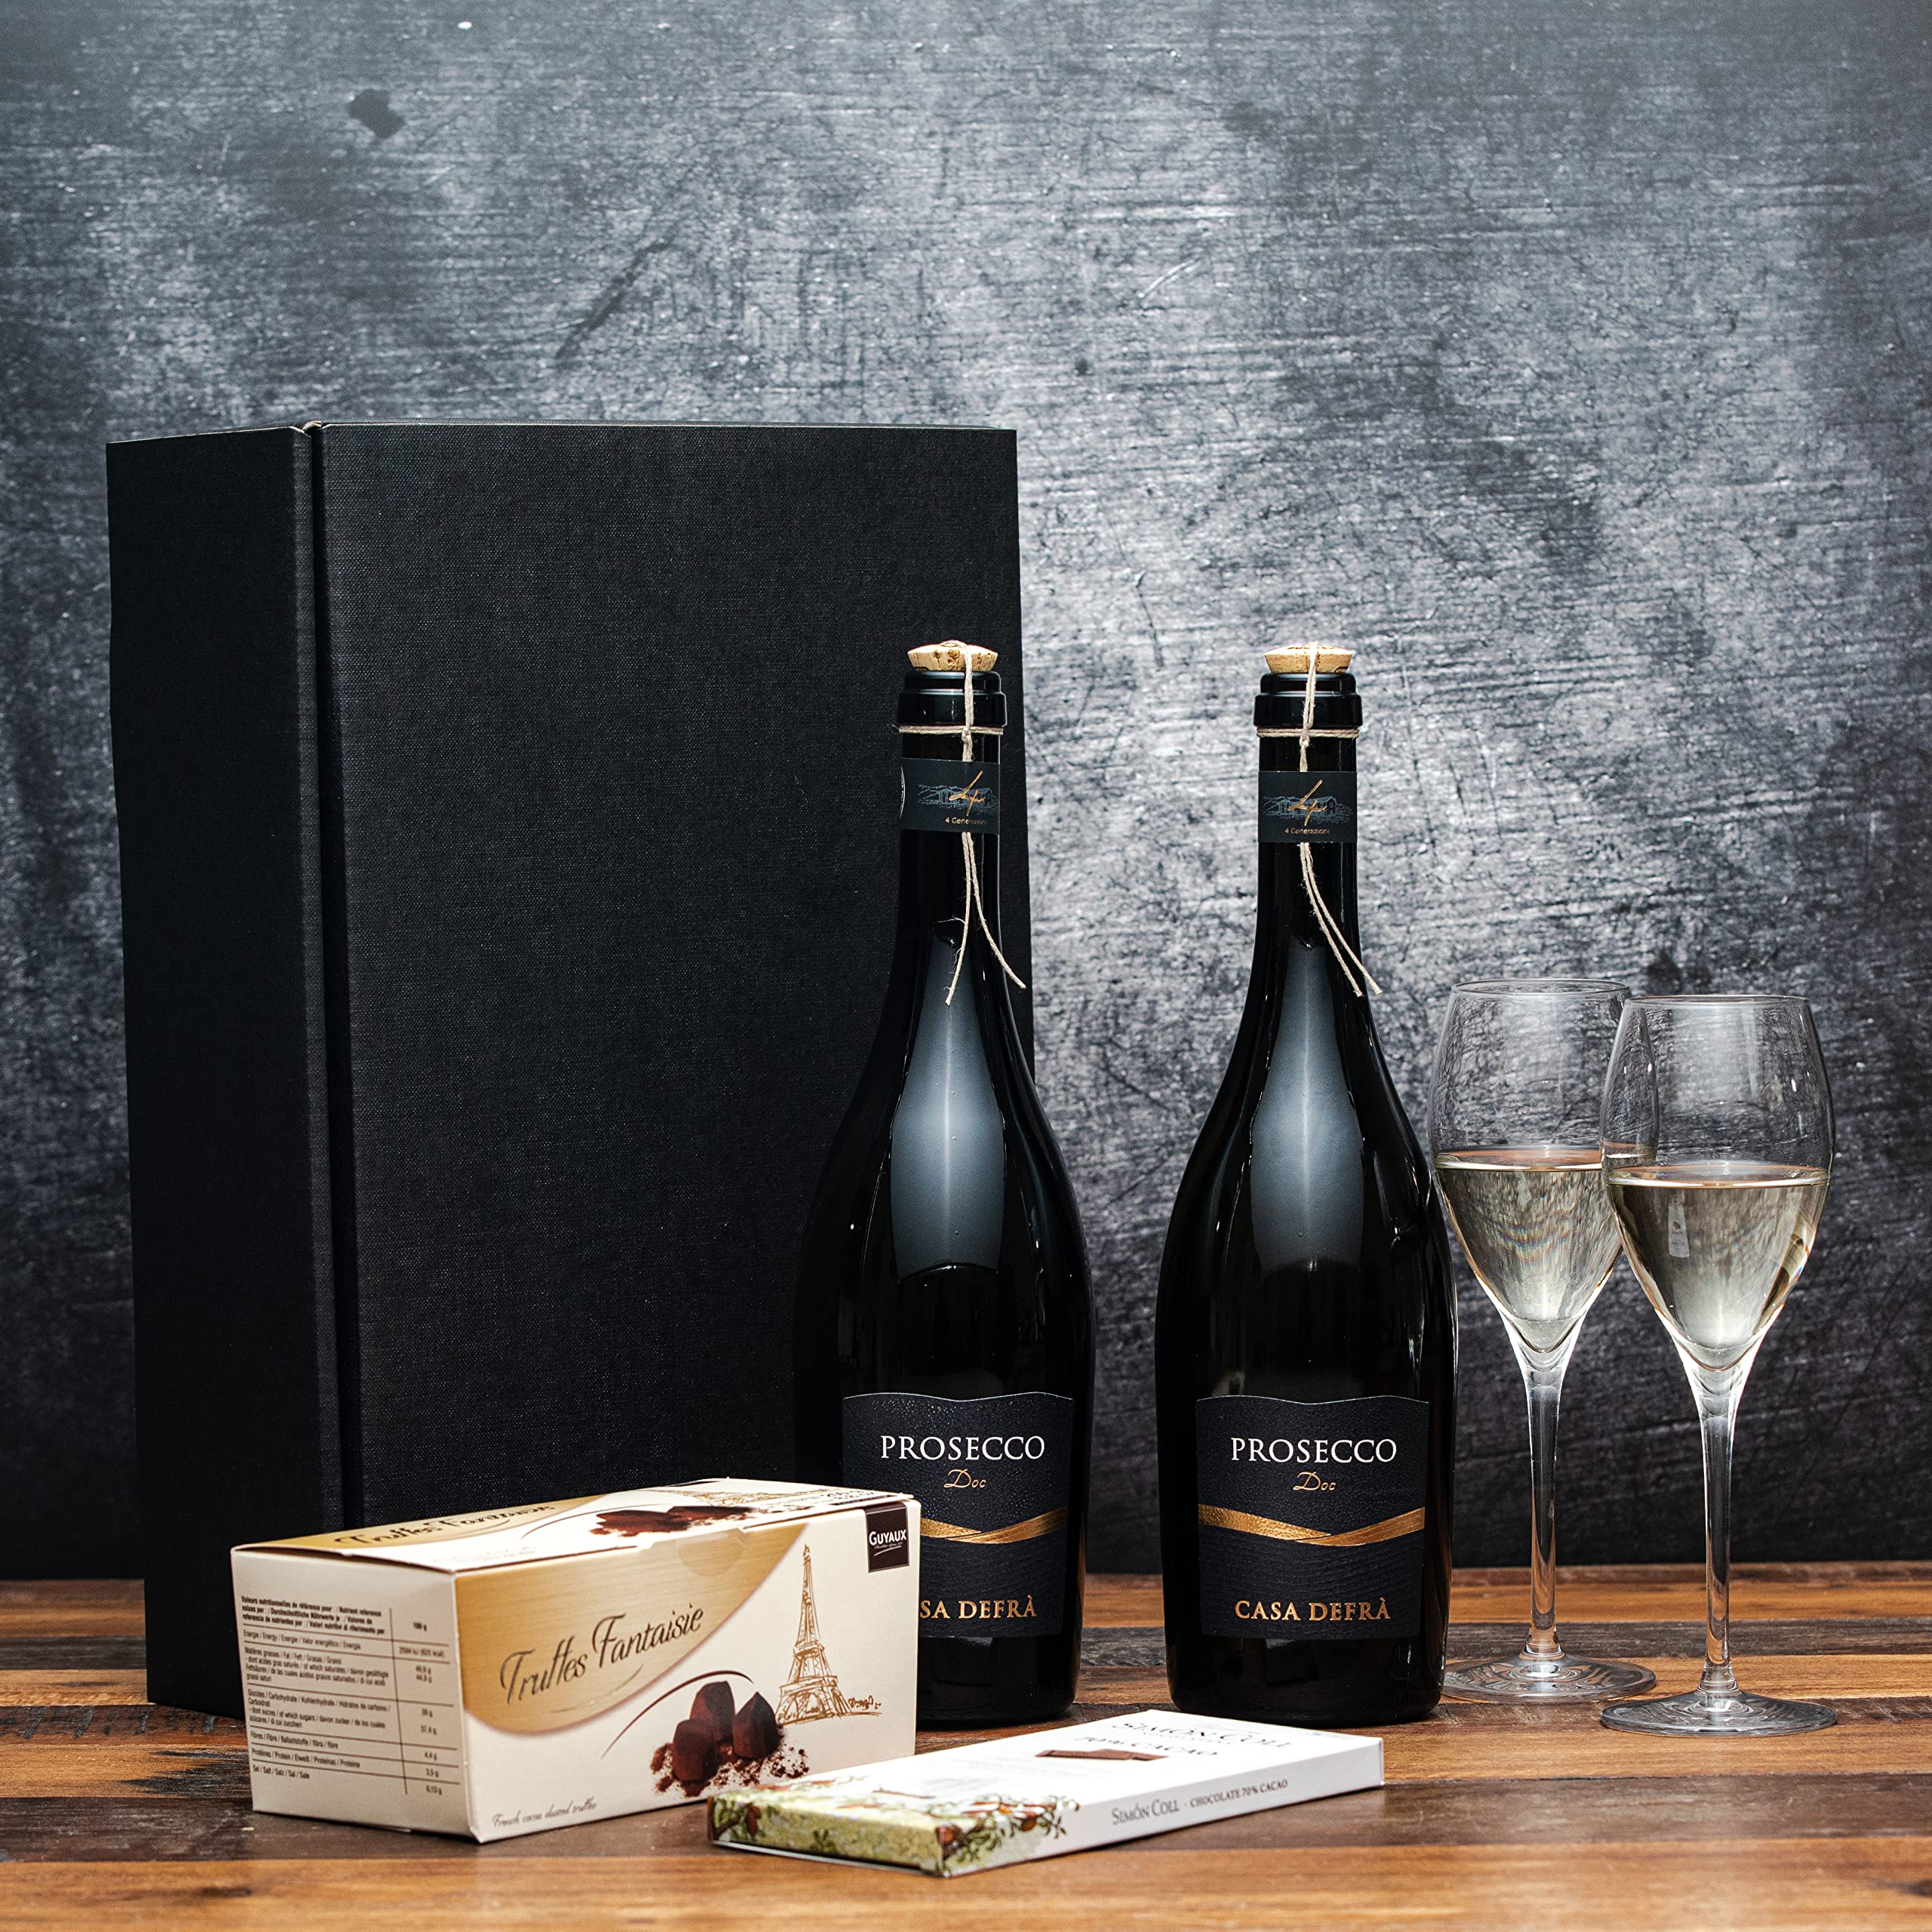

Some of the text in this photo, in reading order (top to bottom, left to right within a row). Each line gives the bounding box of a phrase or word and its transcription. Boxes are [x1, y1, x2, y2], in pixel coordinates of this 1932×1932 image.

[880, 1435, 1045, 1460] PROSECCO
[1231, 1437, 1397, 1463] PROSECCO
[943, 1469, 986, 1488] Doc
[1293, 1472, 1337, 1491] Doc
[869, 1529, 906, 1546] GUYAUX
[919, 1595, 1038, 1619] SA DEFRÀ
[1235, 1597, 1390, 1621] CASA DEFRÀ
[500, 1604, 703, 1704] Truffes Fantaisie
[1189, 1790, 1241, 1808] CHOCOLATE
[1241, 1786, 1259, 1798] 70%
[1260, 1779, 1289, 1793] CACAO
